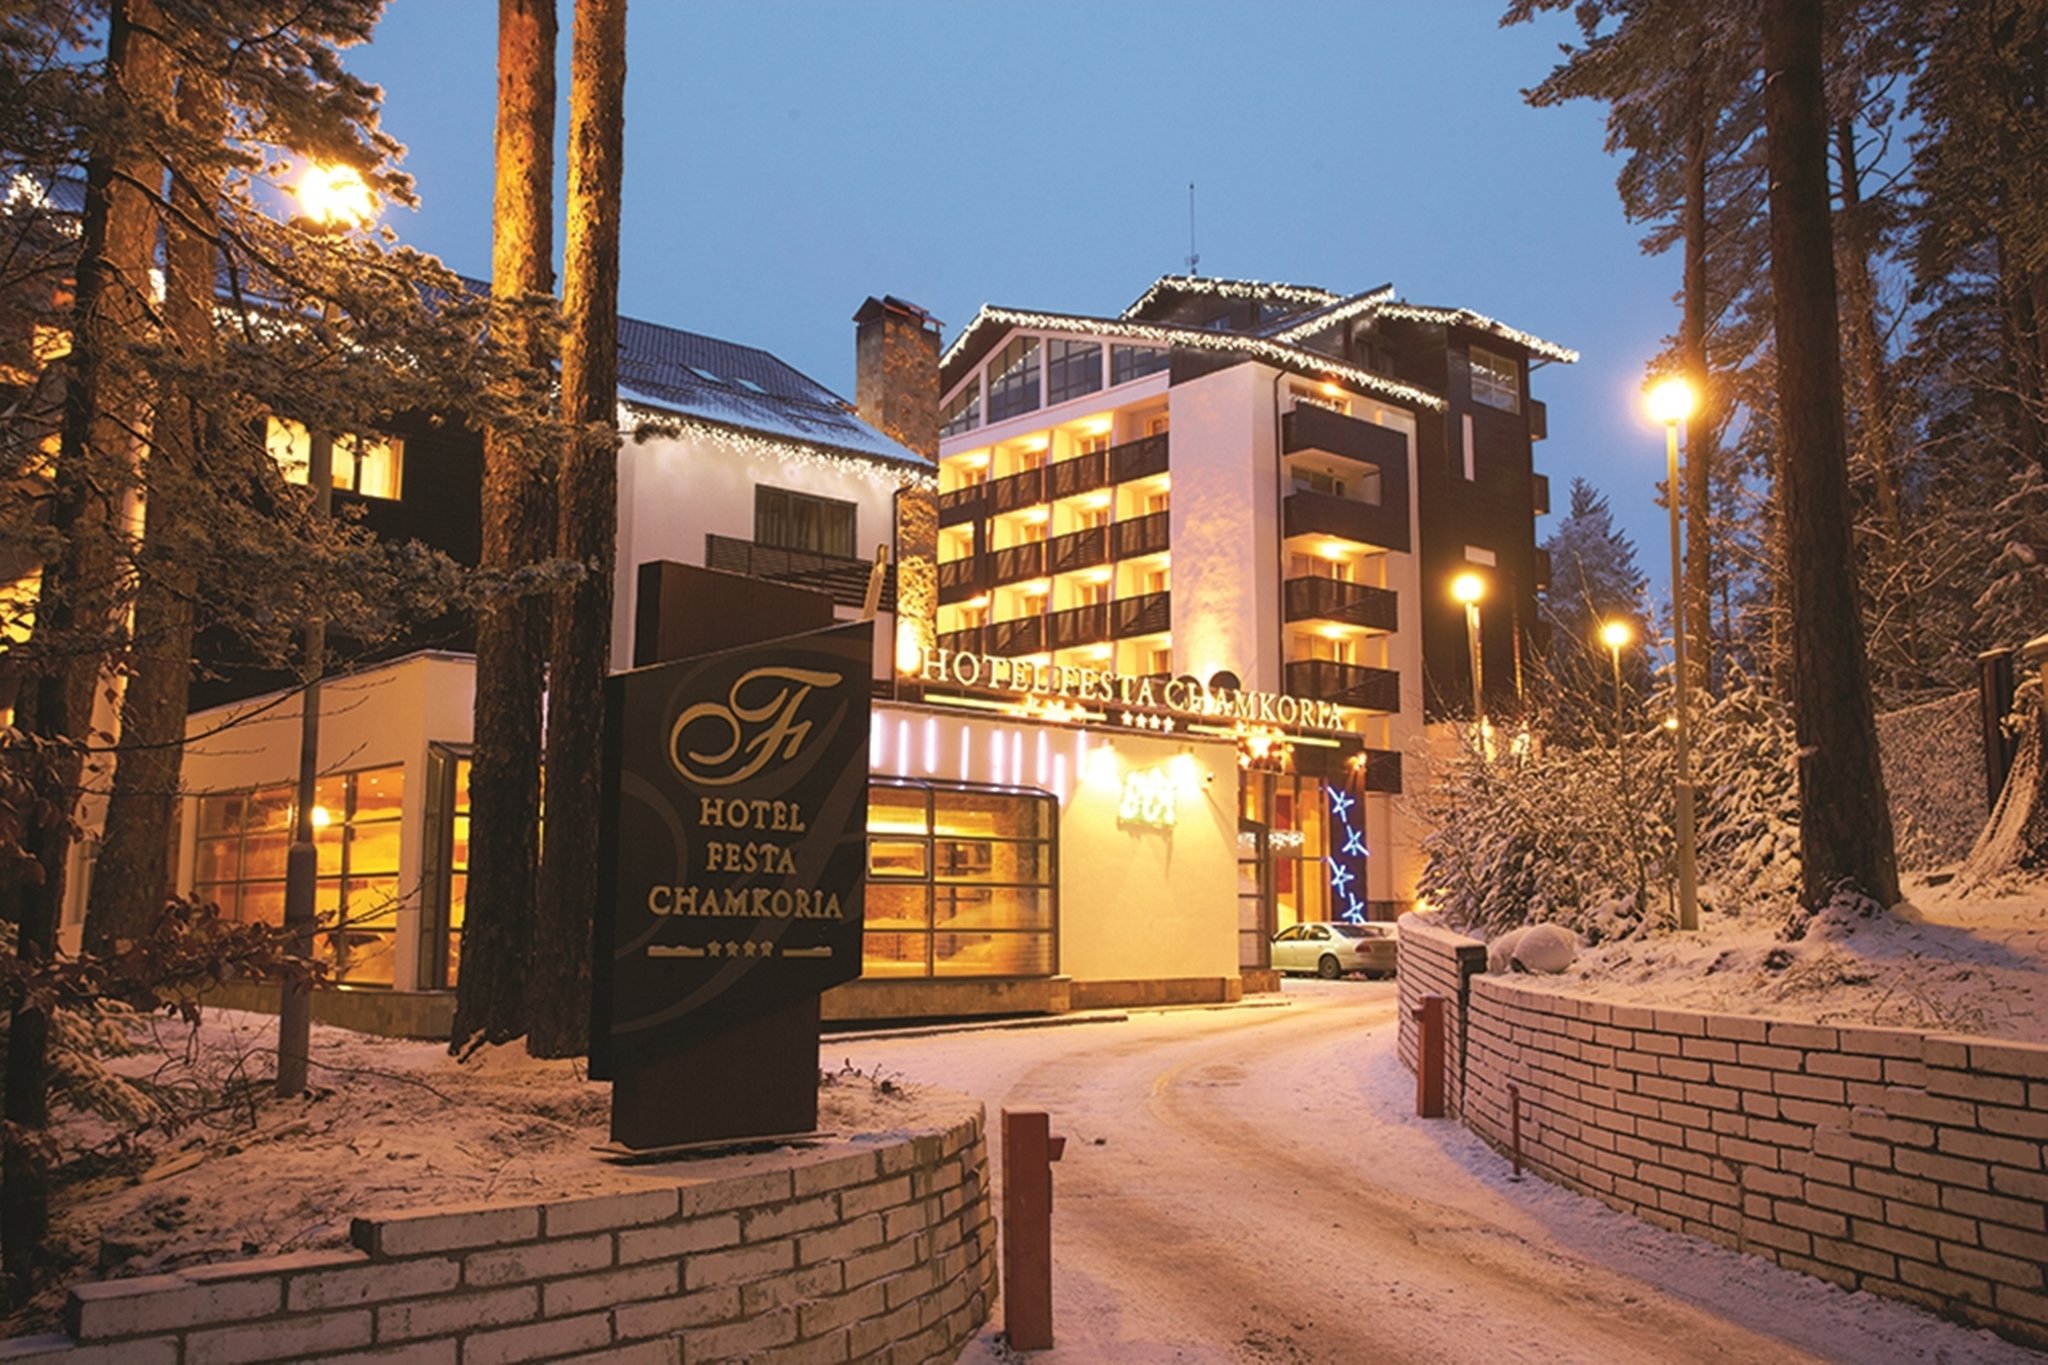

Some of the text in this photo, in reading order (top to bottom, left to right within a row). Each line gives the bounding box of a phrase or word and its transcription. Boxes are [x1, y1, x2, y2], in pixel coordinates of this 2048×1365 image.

[919, 647, 1344, 731] HOTEL FESTA CHAMKORIA
[700, 798, 805, 832] HOTEL
[706, 841, 797, 875] FESTA
[648, 885, 844, 919] CHAMKORIA
